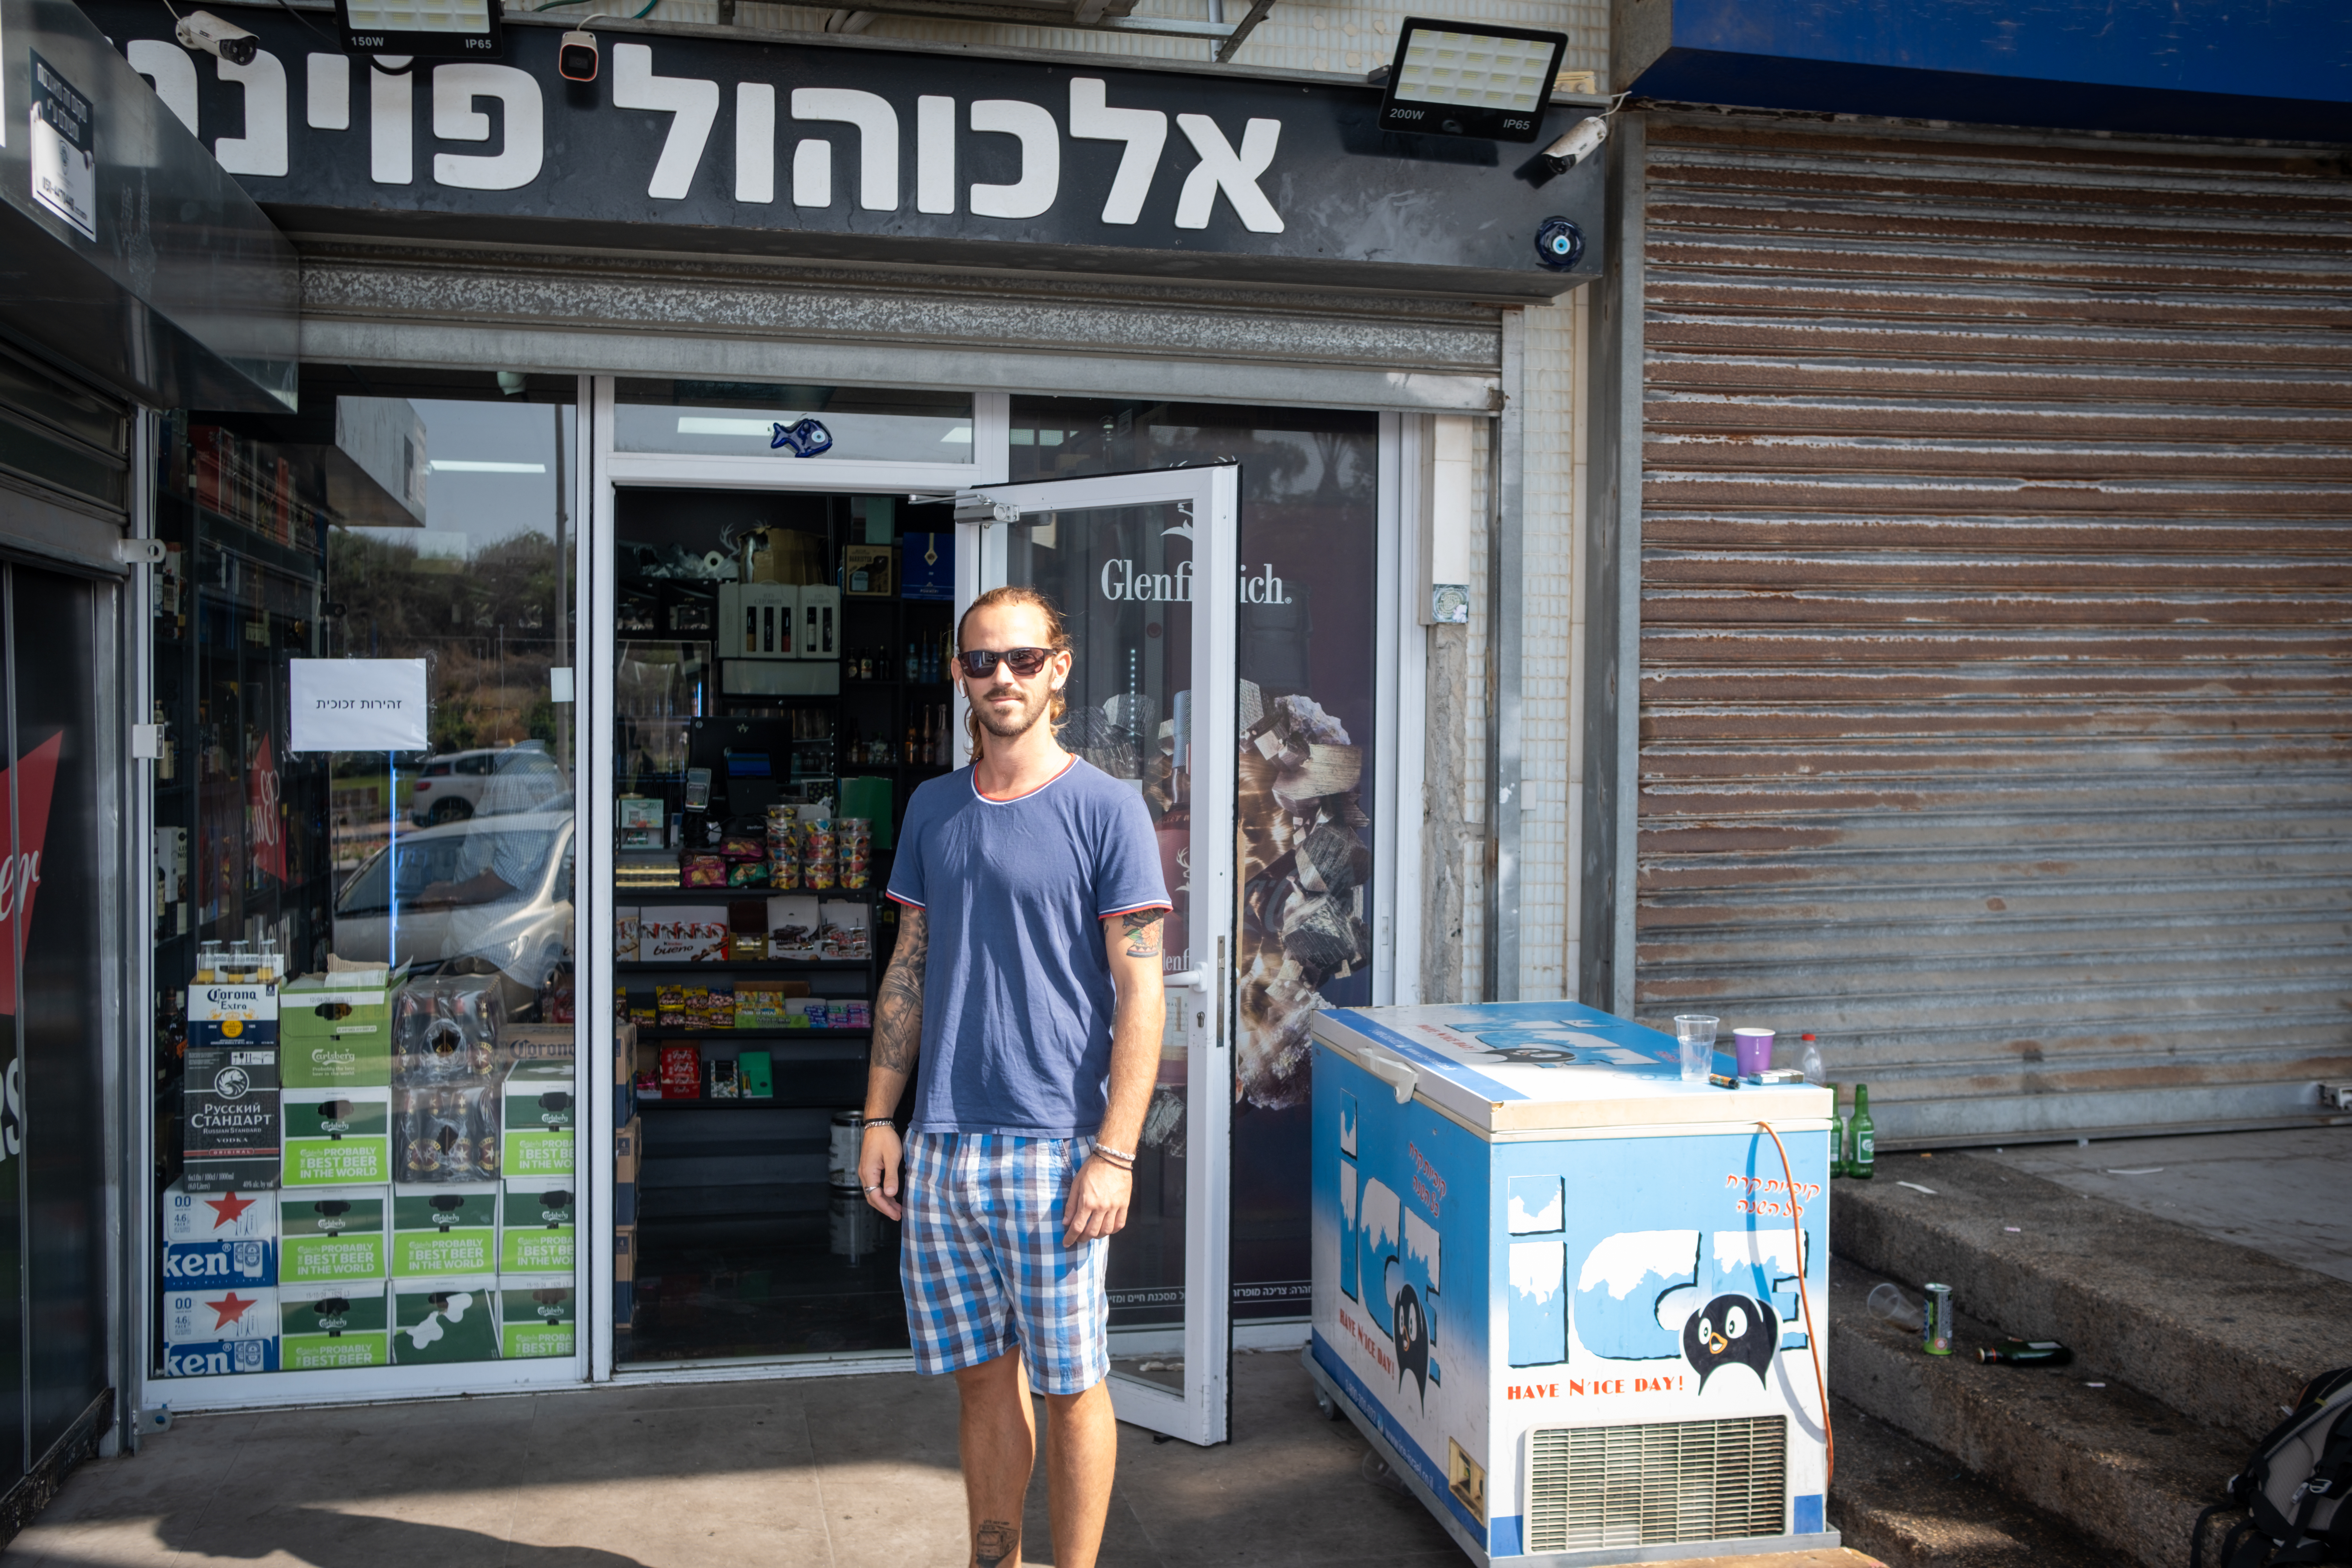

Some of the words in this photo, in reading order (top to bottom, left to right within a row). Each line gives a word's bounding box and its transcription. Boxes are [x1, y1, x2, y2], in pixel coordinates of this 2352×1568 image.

[351, 36, 384, 47] 150W
[465, 38, 492, 50] IP65
[1389, 107, 1425, 121] 200W
[1503, 119, 1530, 131] IP65
[613, 43, 1285, 234] אלכוהול
[1101, 558, 1292, 605] Glenfiich
[316, 700, 355, 709] זכוכית
[360, 700, 402, 709] זהירות
[654, 945, 694, 956] bueno
[207, 988, 256, 1003] Corona
[221, 1001, 247, 1010] Extra
[312, 1048, 355, 1066] Carlsberg
[541, 1113, 568, 1123] Carlsberg
[321, 1121, 349, 1132] Carlsberg
[542, 1139, 574, 1148] PROBA
[324, 1147, 377, 1156] PROBABLY
[526, 1149, 557, 1159] BEST
[560, 1148, 574, 1159] BE
[307, 1156, 340, 1168] BEST
[343, 1155, 377, 1167] BEER
[519, 1161, 530, 1169] IN
[300, 1168, 311, 1179] IN
[313, 1168, 334, 1178] THE
[336, 1167, 377, 1178] WORLD
[1726, 1174, 1762, 1194] קרח
[175, 1196, 191, 1207] 0.0
[1736, 1199, 1779, 1217] השנה
[432, 1213, 459, 1223] Carlsberg
[542, 1210, 568, 1220] Carlsberg
[318, 1219, 346, 1230] Carlsberg
[321, 1243, 373, 1253] PROBABLY
[432, 1239, 483, 1248] PROBABLY
[416, 1249, 448, 1260] BEST
[451, 1248, 483, 1259] BEER
[524, 1245, 556, 1256] BEST
[558, 1245, 574, 1256] BE
[305, 1253, 338, 1266] BEST
[340, 1252, 373, 1264] BEER
[518, 1257, 528, 1266] IN
[530, 1257, 550, 1265] THE
[298, 1265, 308, 1276] IN
[310, 1265, 331, 1275] THE
[334, 1263, 374, 1274] WORLD
[409, 1261, 420, 1270] IN
[421, 1260, 442, 1269] THE
[444, 1260, 484, 1268] WORLD
[1262, 1286, 1287, 1296] צריכה
[1289, 1285, 1312, 1295] זהרה:
[1127, 1294, 1145, 1303] חיים
[1147, 1292, 1176, 1301] מסכנת
[175, 1298, 192, 1309] 0.0
[537, 1306, 564, 1316] Carlsberg
[319, 1318, 347, 1329] Carlsberg
[539, 1334, 573, 1342] PROBA
[320, 1344, 372, 1354] PROBABLY
[522, 1343, 554, 1354] BEST
[557, 1342, 573, 1353] BE
[1339, 1308, 1356, 1338] HAVE
[1377, 1347, 1395, 1380] DAY!
[303, 1355, 337, 1367] BEST
[339, 1353, 372, 1365] BEER
[1508, 1383, 1560, 1400] HAVE
[1634, 1375, 1683, 1393] DAY!
